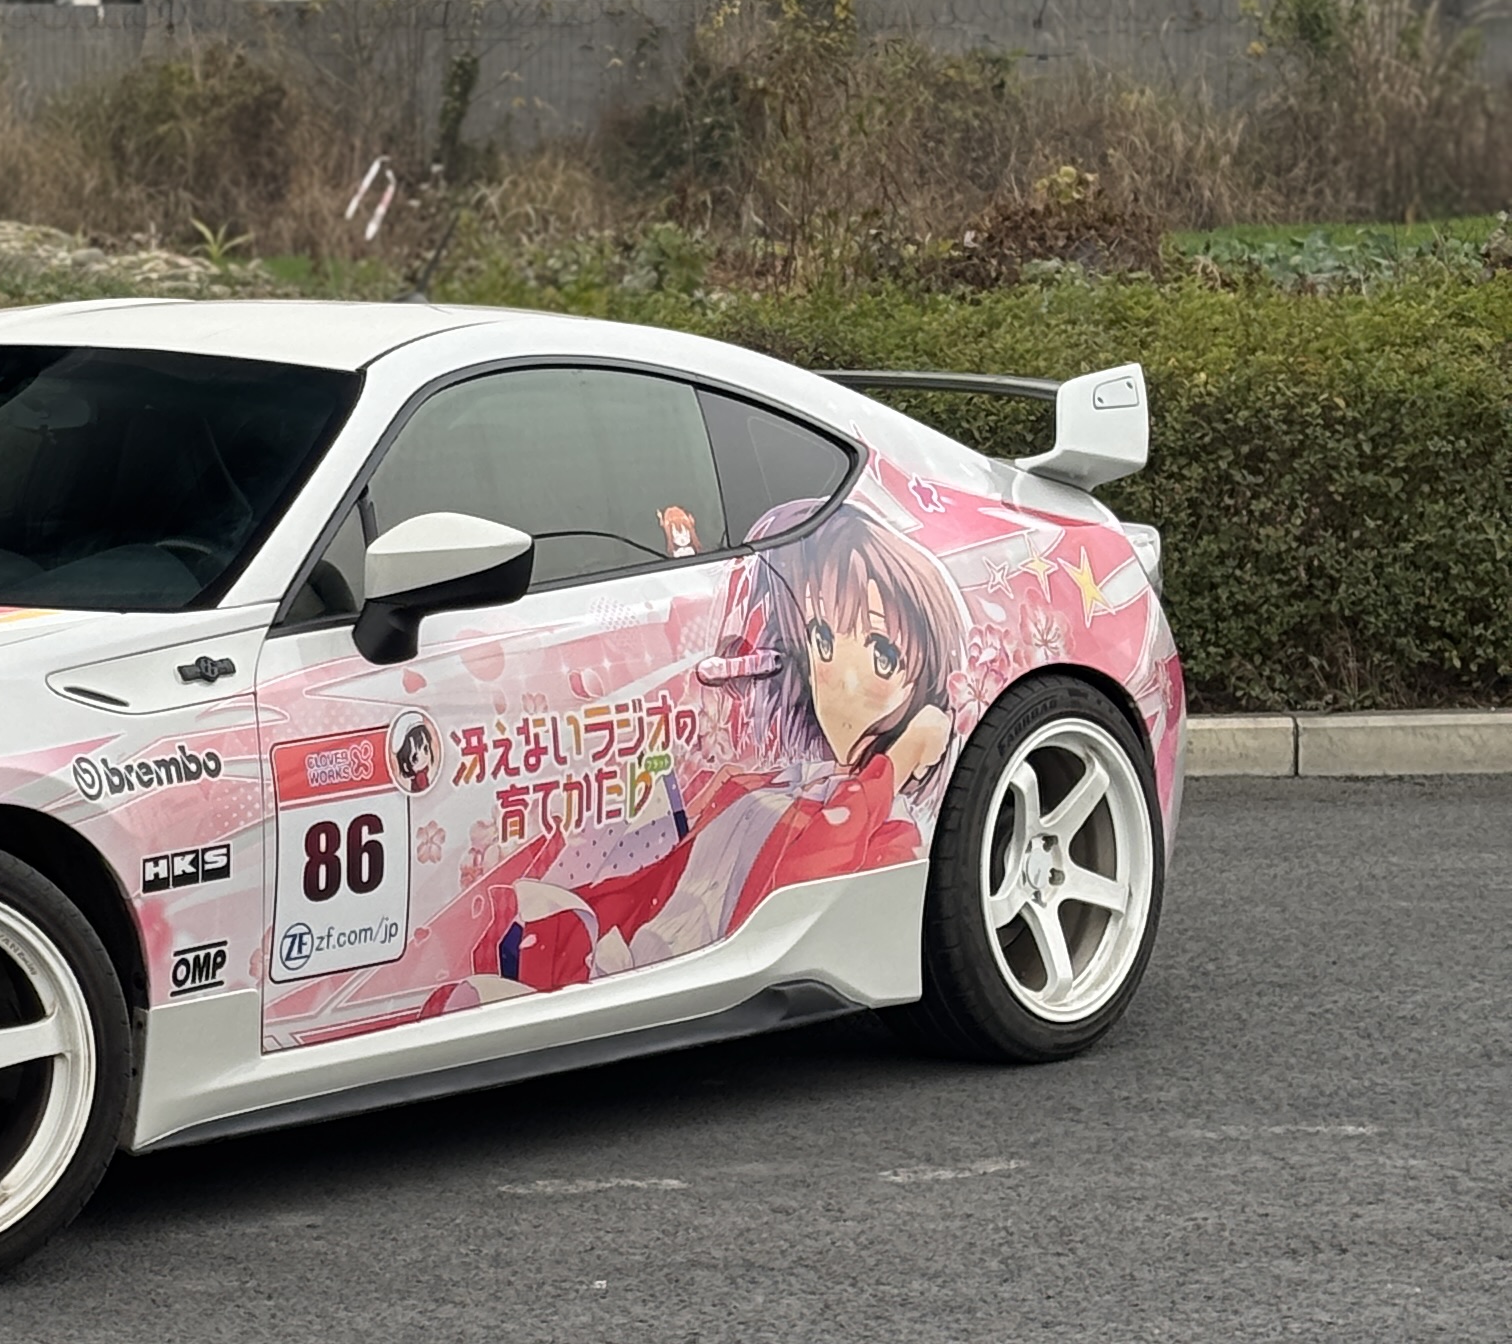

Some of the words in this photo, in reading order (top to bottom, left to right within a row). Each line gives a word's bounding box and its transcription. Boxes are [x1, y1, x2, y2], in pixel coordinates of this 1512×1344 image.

[449, 694, 697, 786] 冴えないラジオの
[100, 745, 222, 795] brembo
[307, 750, 349, 770] CLOVER
[308, 765, 351, 787] WORKS
[144, 846, 229, 883] HKS
[303, 813, 385, 903] 86
[314, 917, 399, 952] zf.com/jp
[172, 949, 227, 988] OMP
